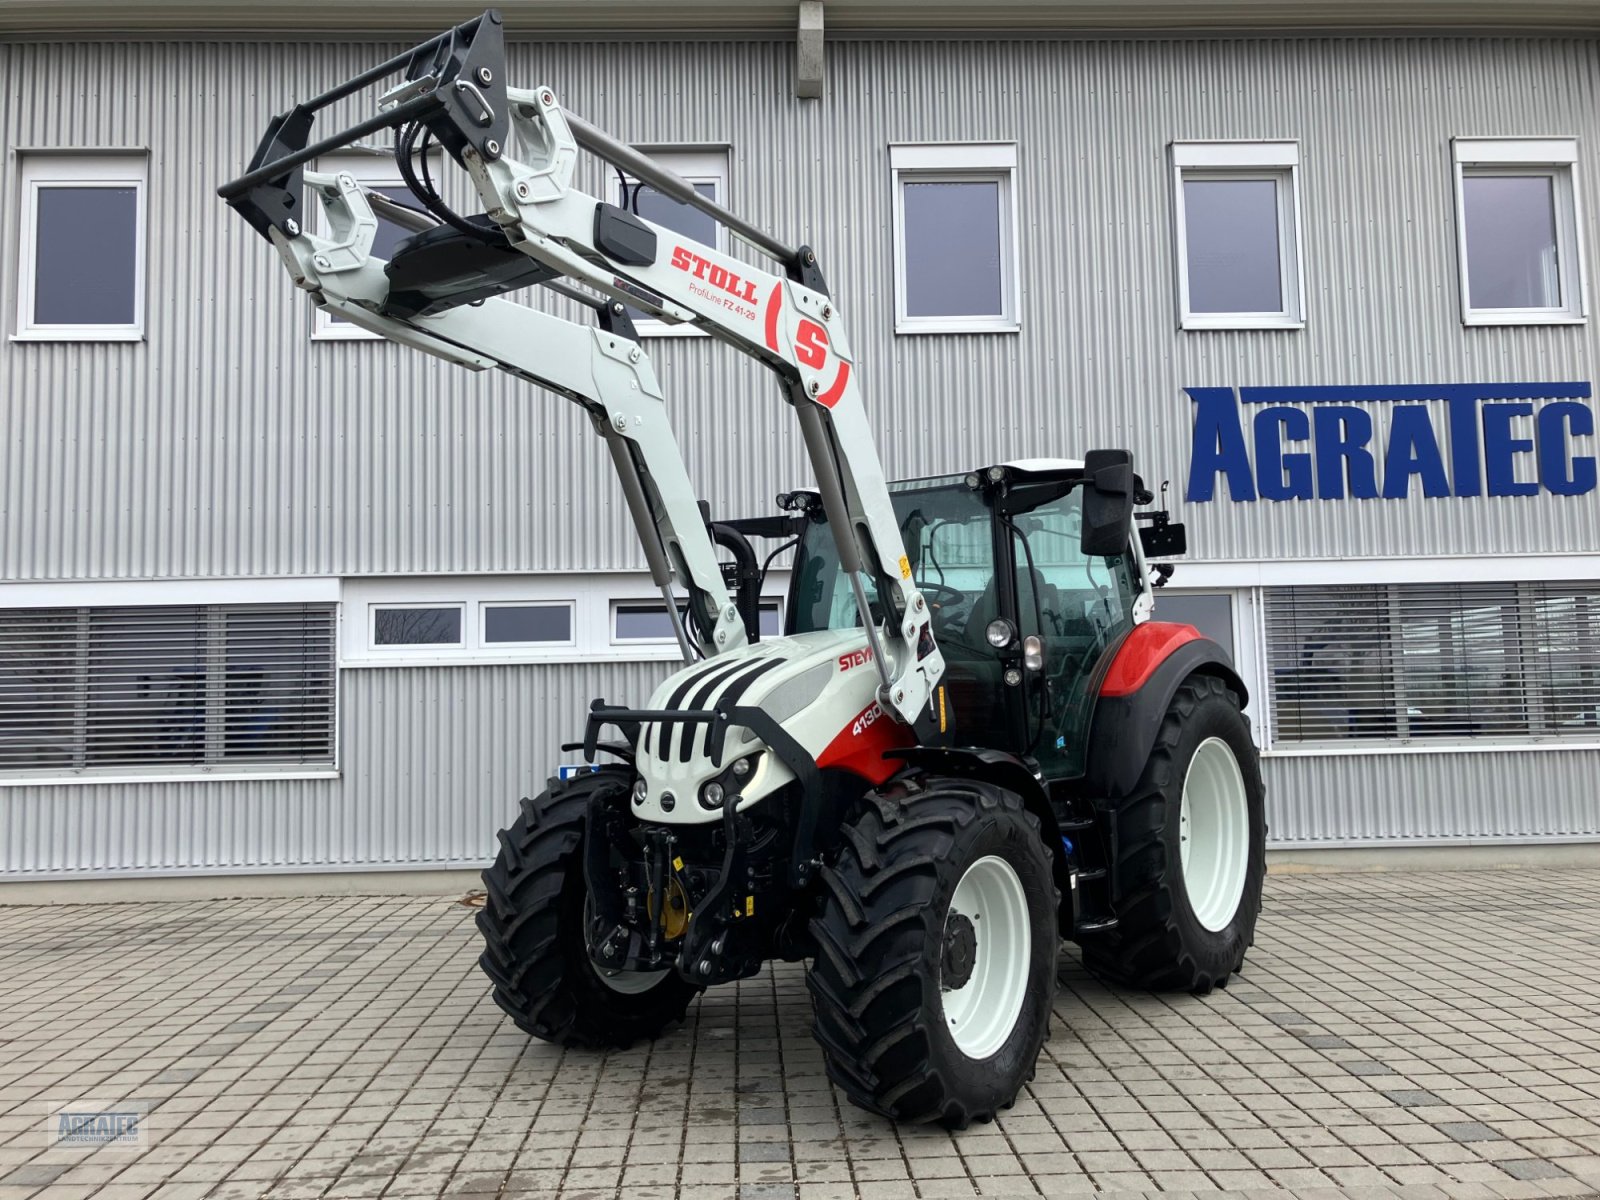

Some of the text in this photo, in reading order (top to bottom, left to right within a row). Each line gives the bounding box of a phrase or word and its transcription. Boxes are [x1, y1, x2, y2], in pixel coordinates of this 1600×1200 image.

[671, 246, 758, 305] STOLL
[689, 283, 721, 305] ProfiLine
[723, 299, 734, 311] FZ
[794, 319, 829, 371] S
[1182, 382, 1598, 502] AGRATEC
[852, 703, 882, 737] 4130
